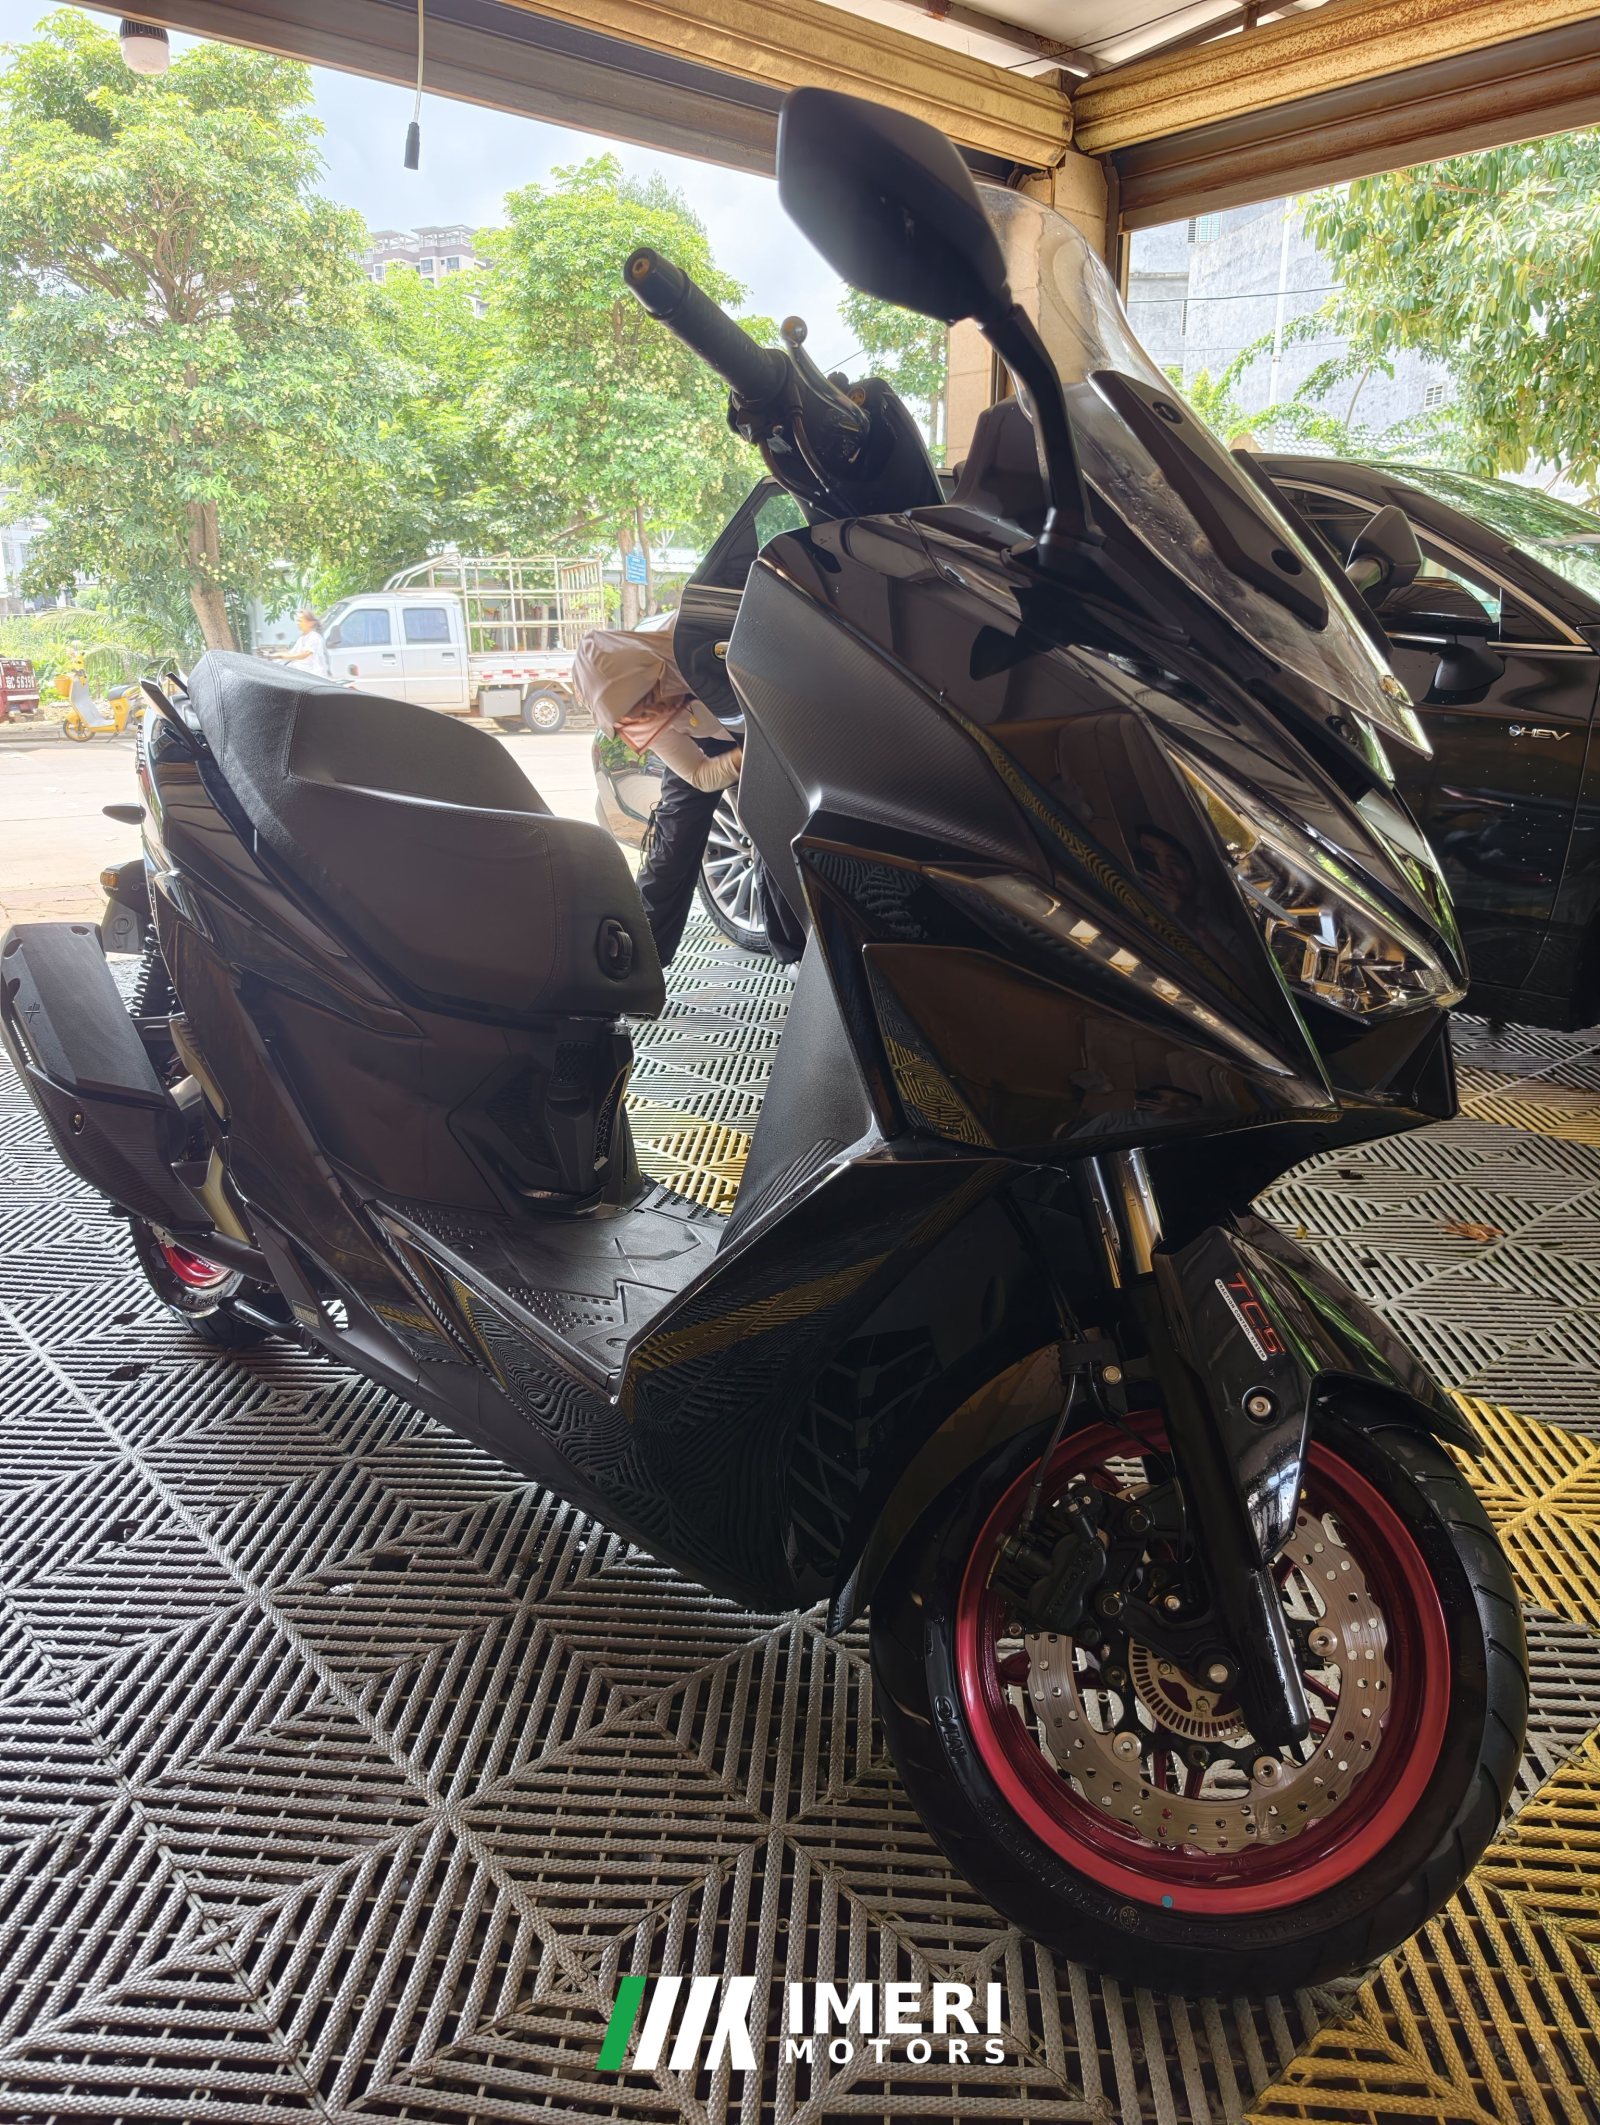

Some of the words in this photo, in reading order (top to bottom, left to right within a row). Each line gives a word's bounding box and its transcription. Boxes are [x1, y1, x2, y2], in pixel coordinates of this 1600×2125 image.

[1215, 1280, 1236, 1308] TRACTION
[1233, 1308, 1253, 1336] CONTROL
[1249, 1335, 1266, 1359] SYSTEM
[1227, 1271, 1287, 1355] TCS
